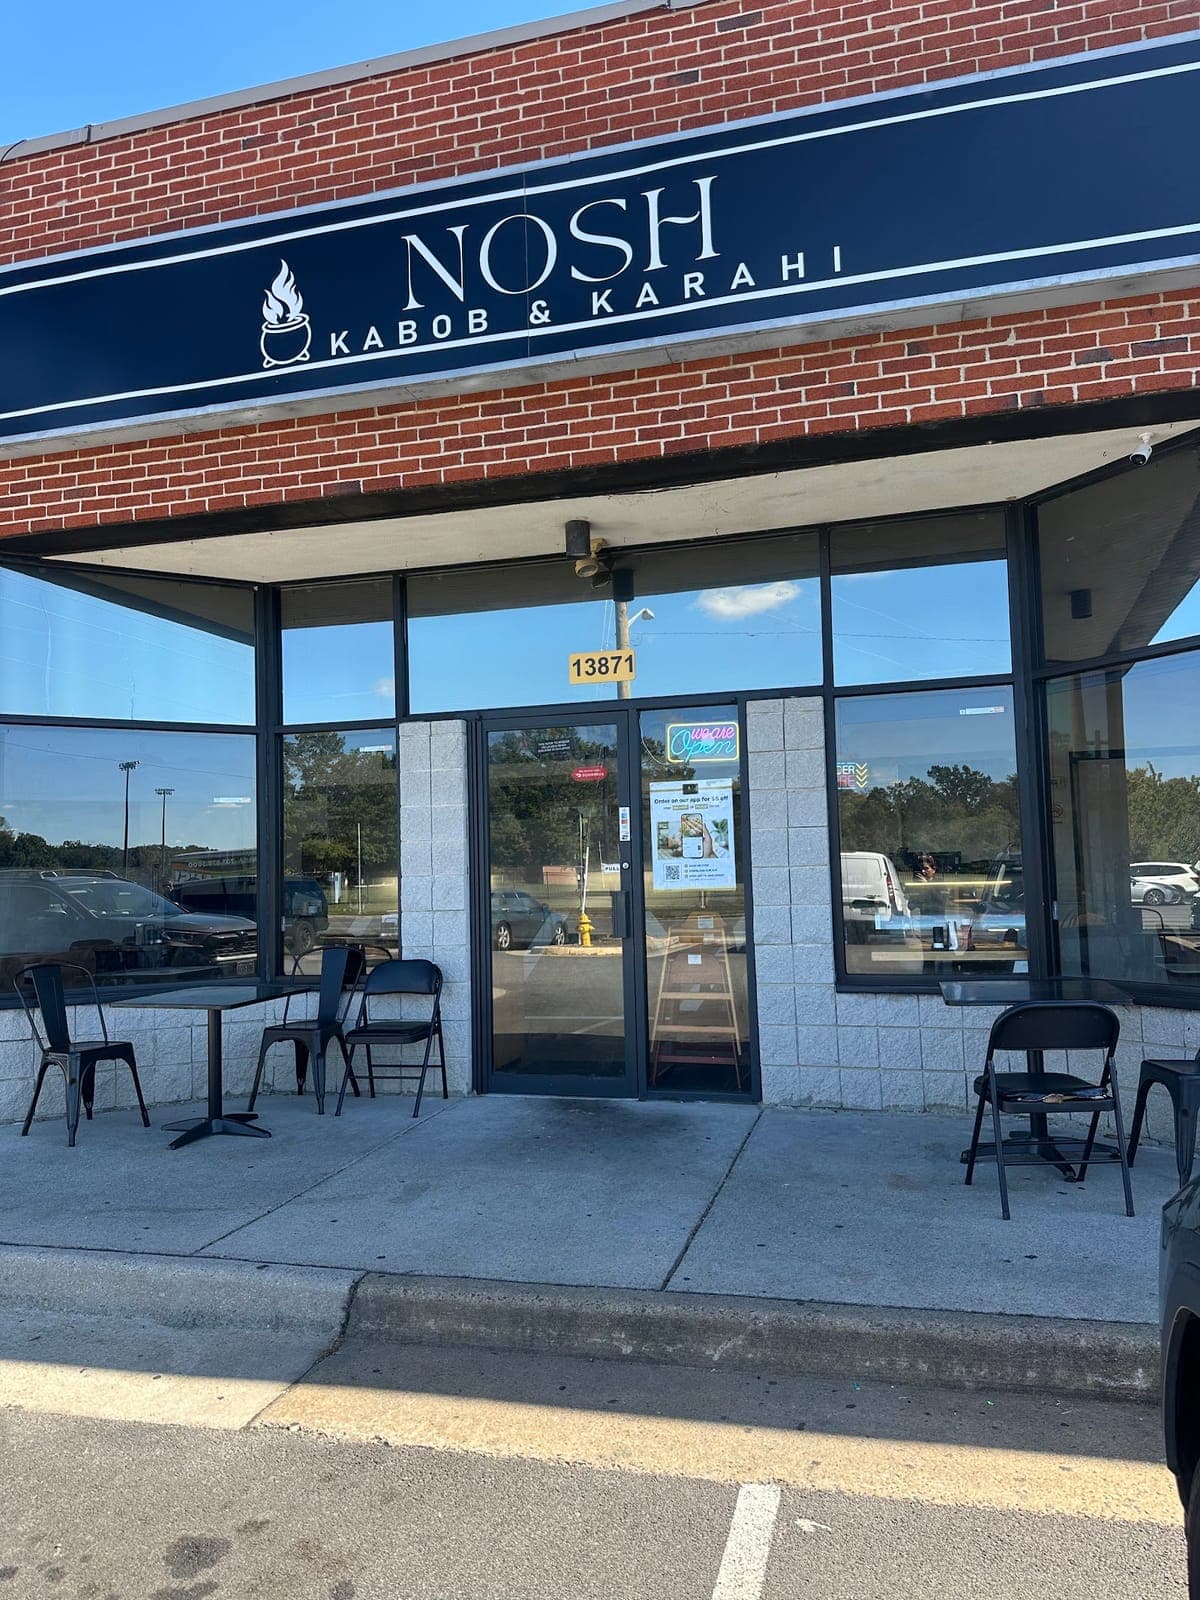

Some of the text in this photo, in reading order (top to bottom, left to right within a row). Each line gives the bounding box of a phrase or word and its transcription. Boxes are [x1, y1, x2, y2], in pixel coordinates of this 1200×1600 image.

[400, 175, 721, 311] NOSH
[330, 245, 841, 357] KABOB & KARAHI
[572, 654, 633, 677] 13871
[671, 729, 736, 763] Open
